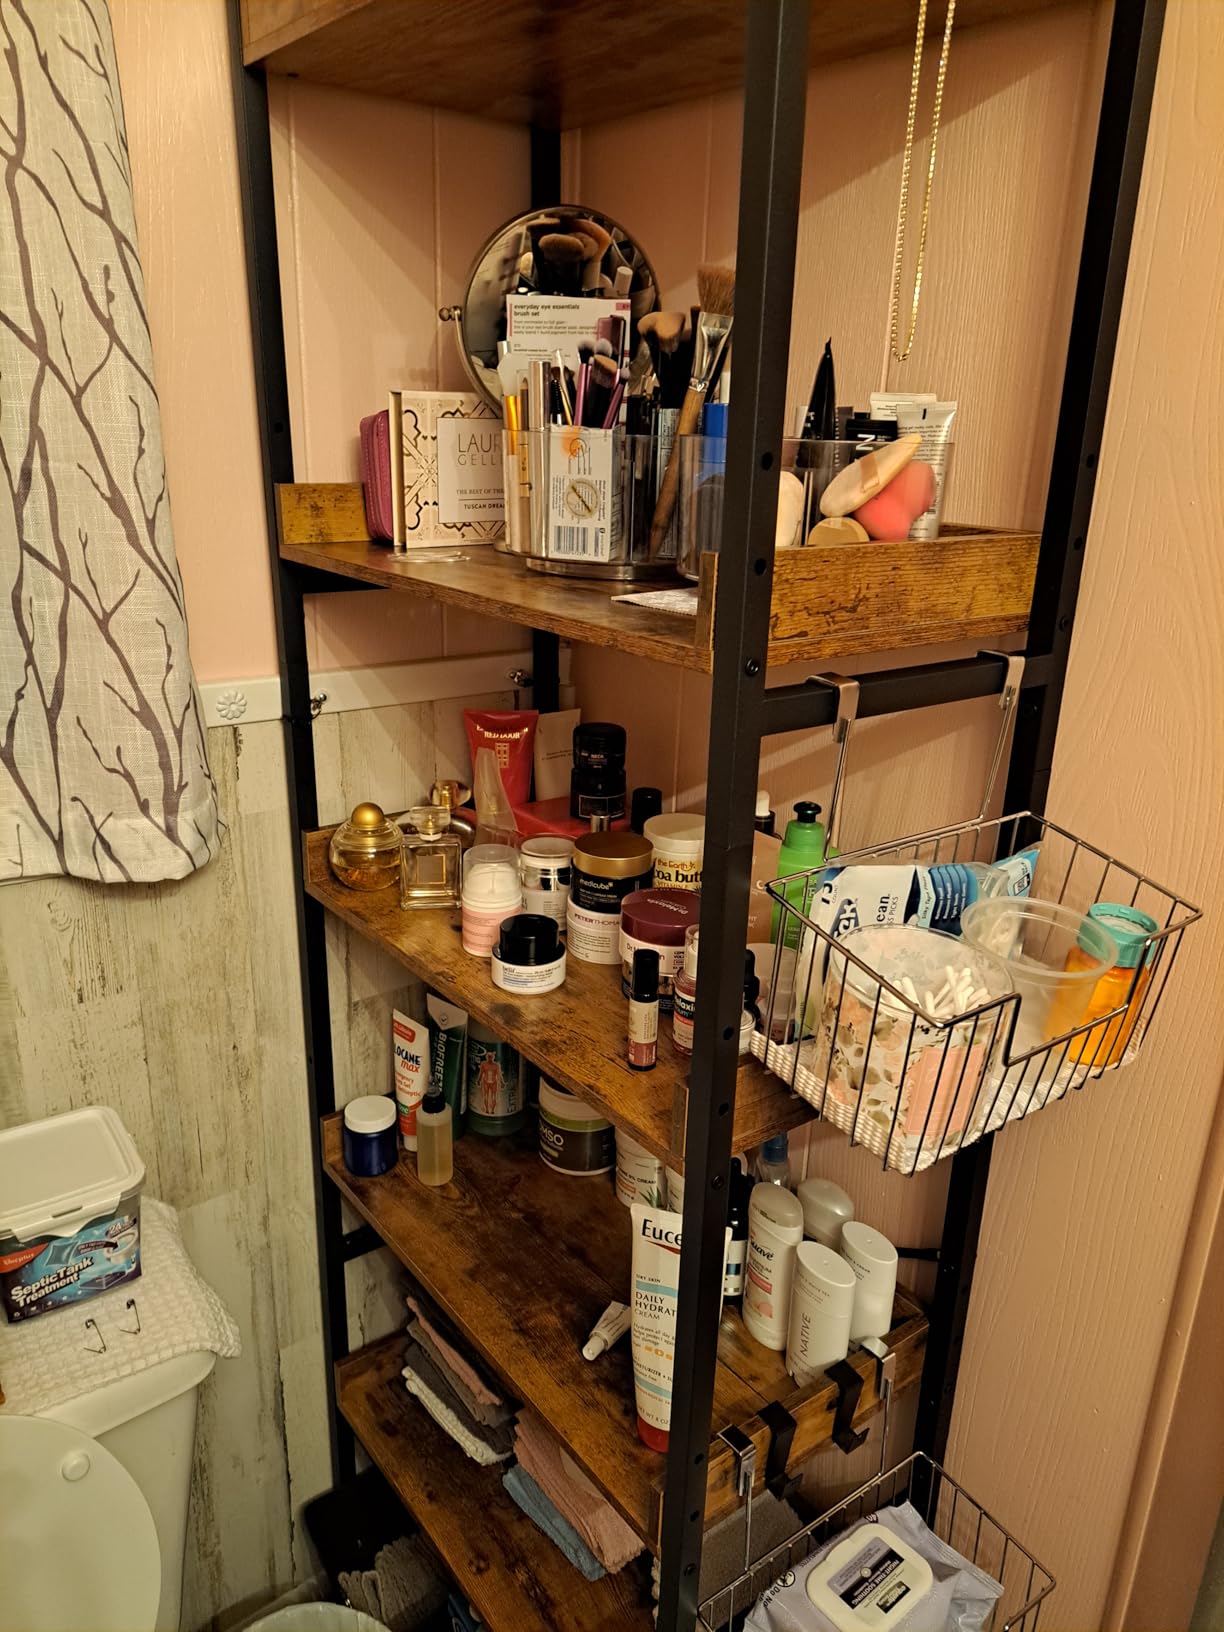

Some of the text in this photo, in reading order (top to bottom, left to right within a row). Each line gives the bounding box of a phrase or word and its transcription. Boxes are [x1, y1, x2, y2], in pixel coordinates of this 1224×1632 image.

[458, 433, 503, 453] LAUR
[457, 454, 503, 466] GELL
[579, 878, 610, 890] medicube
[655, 869, 703, 883] coa butt
[876, 896, 889, 922] ean
[889, 896, 899, 916] PICKS
[394, 1043, 422, 1066] LOCANE
[400, 1059, 420, 1073] max
[540, 1123, 565, 1147] MSO
[641, 1218, 682, 1246] Euce
[11, 1273, 58, 1301] Septic
[57, 1256, 95, 1280] Tank
[15, 1272, 80, 1308] Treatment
[635, 1291, 665, 1305] DAILY
[634, 1308, 661, 1320] CREAM
[635, 1299, 677, 1317] HYDRAT
[800, 1312, 812, 1358] NATIVE
[884, 1559, 900, 1575] NIGHT
[769, 1585, 781, 1597] Do
[851, 1581, 877, 1606] SOOTHING
[762, 1595, 773, 1610] No
